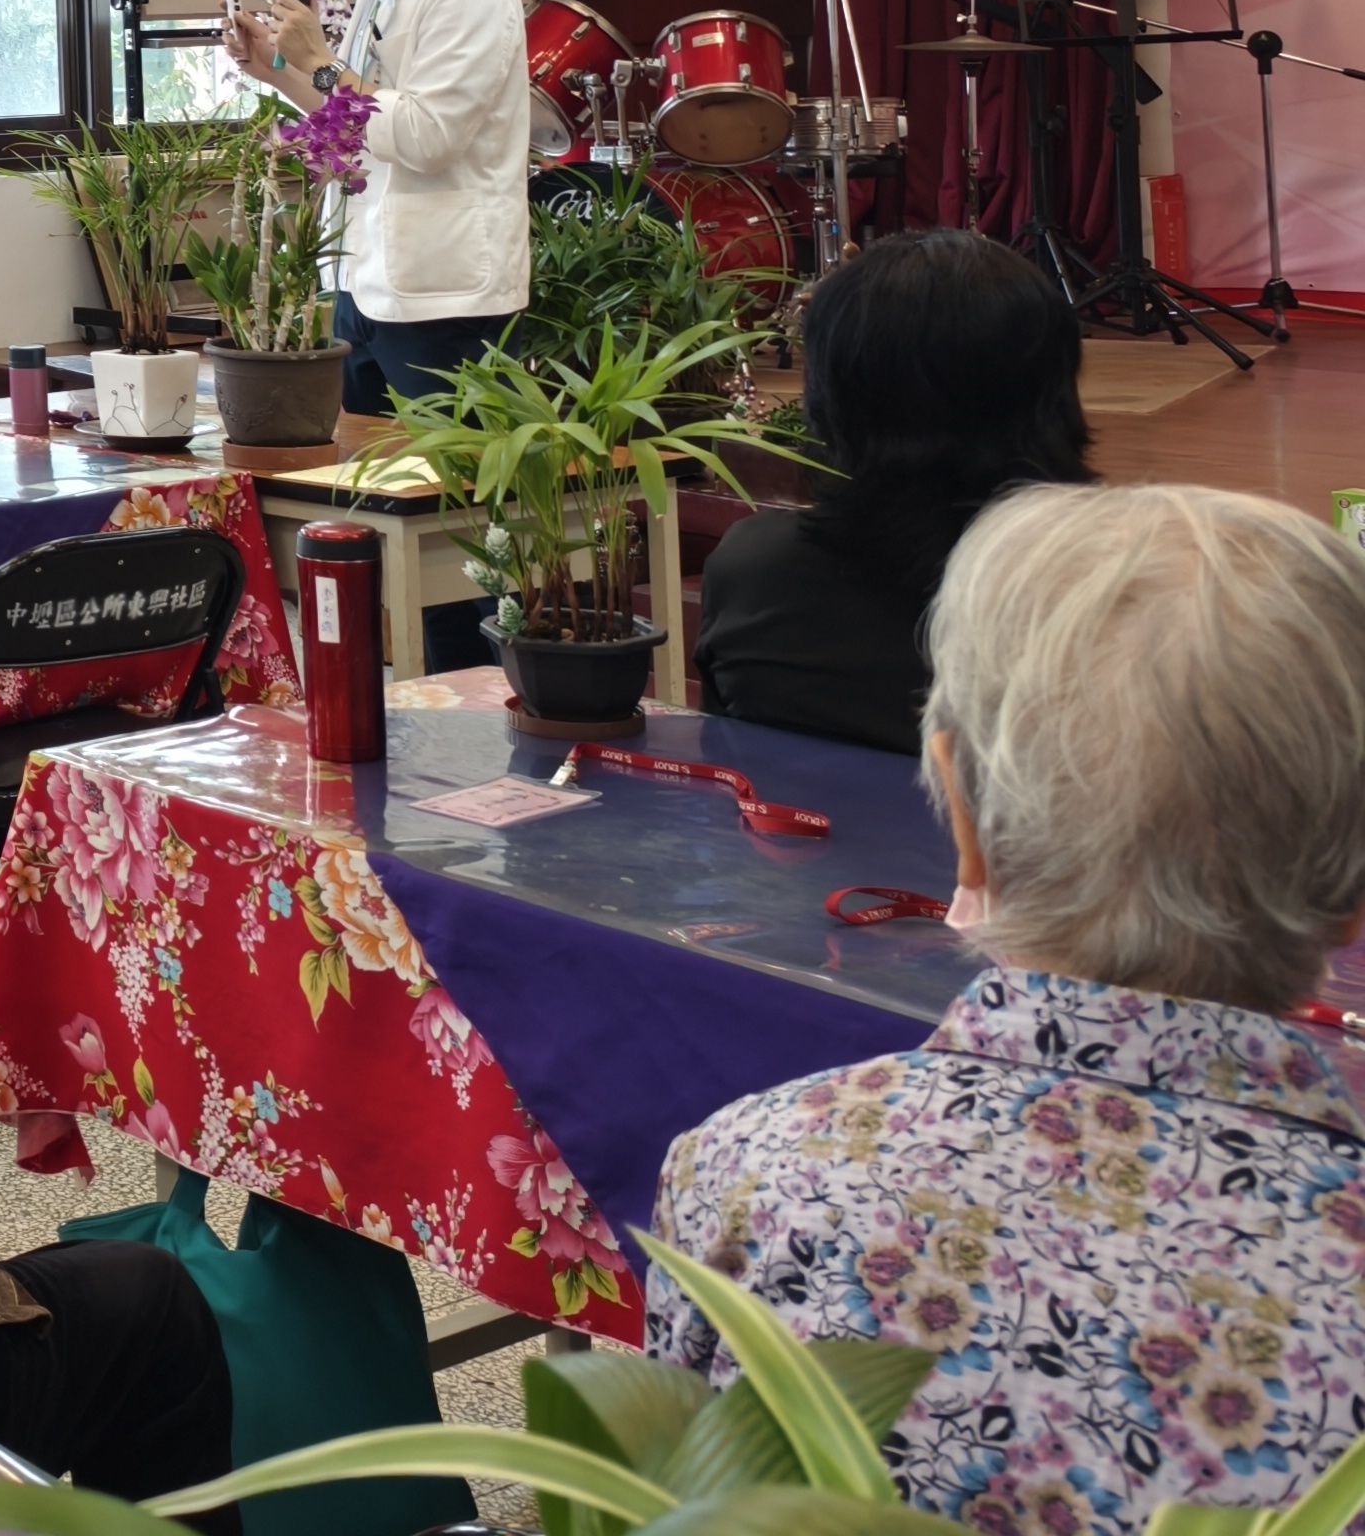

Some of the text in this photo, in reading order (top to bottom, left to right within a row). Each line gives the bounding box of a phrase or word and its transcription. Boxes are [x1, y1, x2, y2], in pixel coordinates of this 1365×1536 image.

[6, 579, 208, 629] 中壢區公所東興社區
[653, 760, 680, 773] ENJOY
